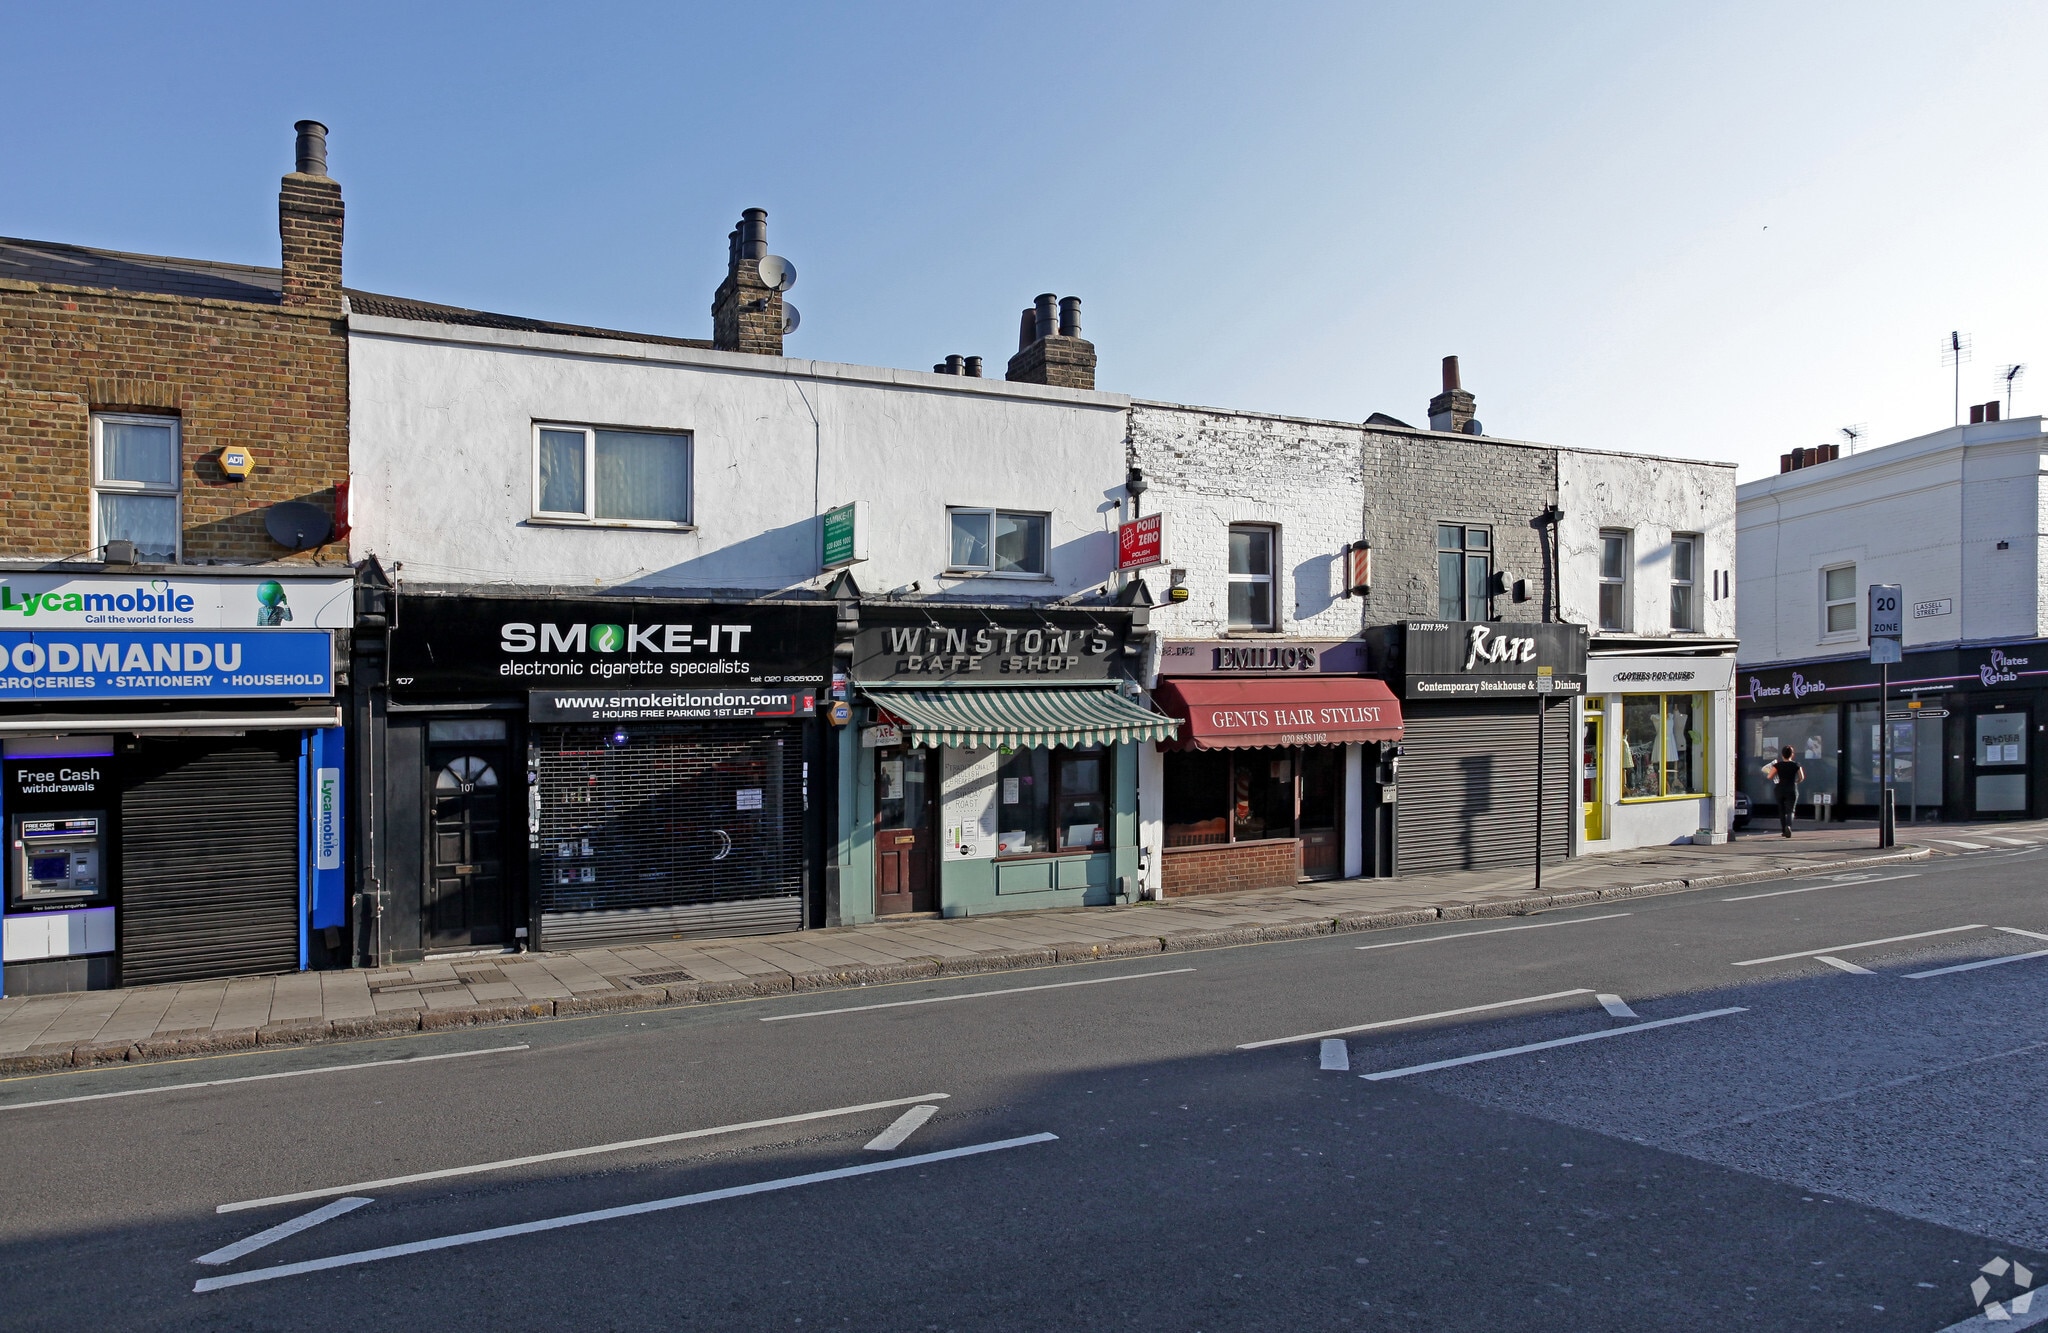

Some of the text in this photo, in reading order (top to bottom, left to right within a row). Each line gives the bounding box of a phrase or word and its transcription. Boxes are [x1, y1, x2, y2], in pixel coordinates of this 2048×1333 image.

[227, 456, 243, 464] ADT
[1136, 516, 1160, 533] POINT
[1138, 530, 1159, 546] ZERO
[1122, 554, 1160, 567] DELICATESSEN
[1131, 549, 1151, 558] POLISH
[1, 586, 195, 616] Lycamobile
[1877, 597, 1896, 611] 20
[1916, 602, 1942, 610] LASSELL
[85, 615, 194, 624] Call the world for less
[1916, 609, 1939, 617] STREET
[1874, 623, 1899, 632] ZONE
[891, 627, 1107, 654] WINSTON'S
[1466, 624, 1537, 670] Rare
[0, 642, 242, 673] ODMANDU
[908, 656, 1079, 671] CAFE SHOP
[1218, 646, 1316, 670] EMILIO'S
[1991, 648, 2028, 671] Pilates
[500, 659, 750, 679] electronic cigarette specialists
[1617, 671, 1695, 681] CLOTHES FOR CAUSES
[1980, 663, 2017, 687] Rehab
[0, 674, 324, 689] GROCERIES STATIONERY HOUSEHOLD
[396, 677, 413, 685] 107
[764, 675, 782, 683] 020
[1417, 680, 1479, 693] Contemporary
[1480, 679, 1526, 691] Steakhouse
[1527, 680, 1535, 690] &
[1554, 679, 1581, 692] Dining
[1750, 671, 1825, 703] Pilates & Rehab
[554, 692, 788, 709] www.smokeitlondon.com
[592, 707, 755, 719] 2 HOURS FREE PARKING 1ST LEFT
[836, 709, 847, 717] ADT
[1212, 706, 1381, 728] GENTS HAIR STYLIST
[1281, 733, 1327, 744] 020 8858 1162
[949, 763, 990, 771] TRADITIONAL
[953, 770, 980, 778] ENGLISH
[18, 768, 100, 783] Free Cash
[22, 782, 95, 793] withdrawals
[461, 783, 474, 792] 107
[955, 799, 978, 808] ROAST
[321, 780, 334, 857] Lycamobile
